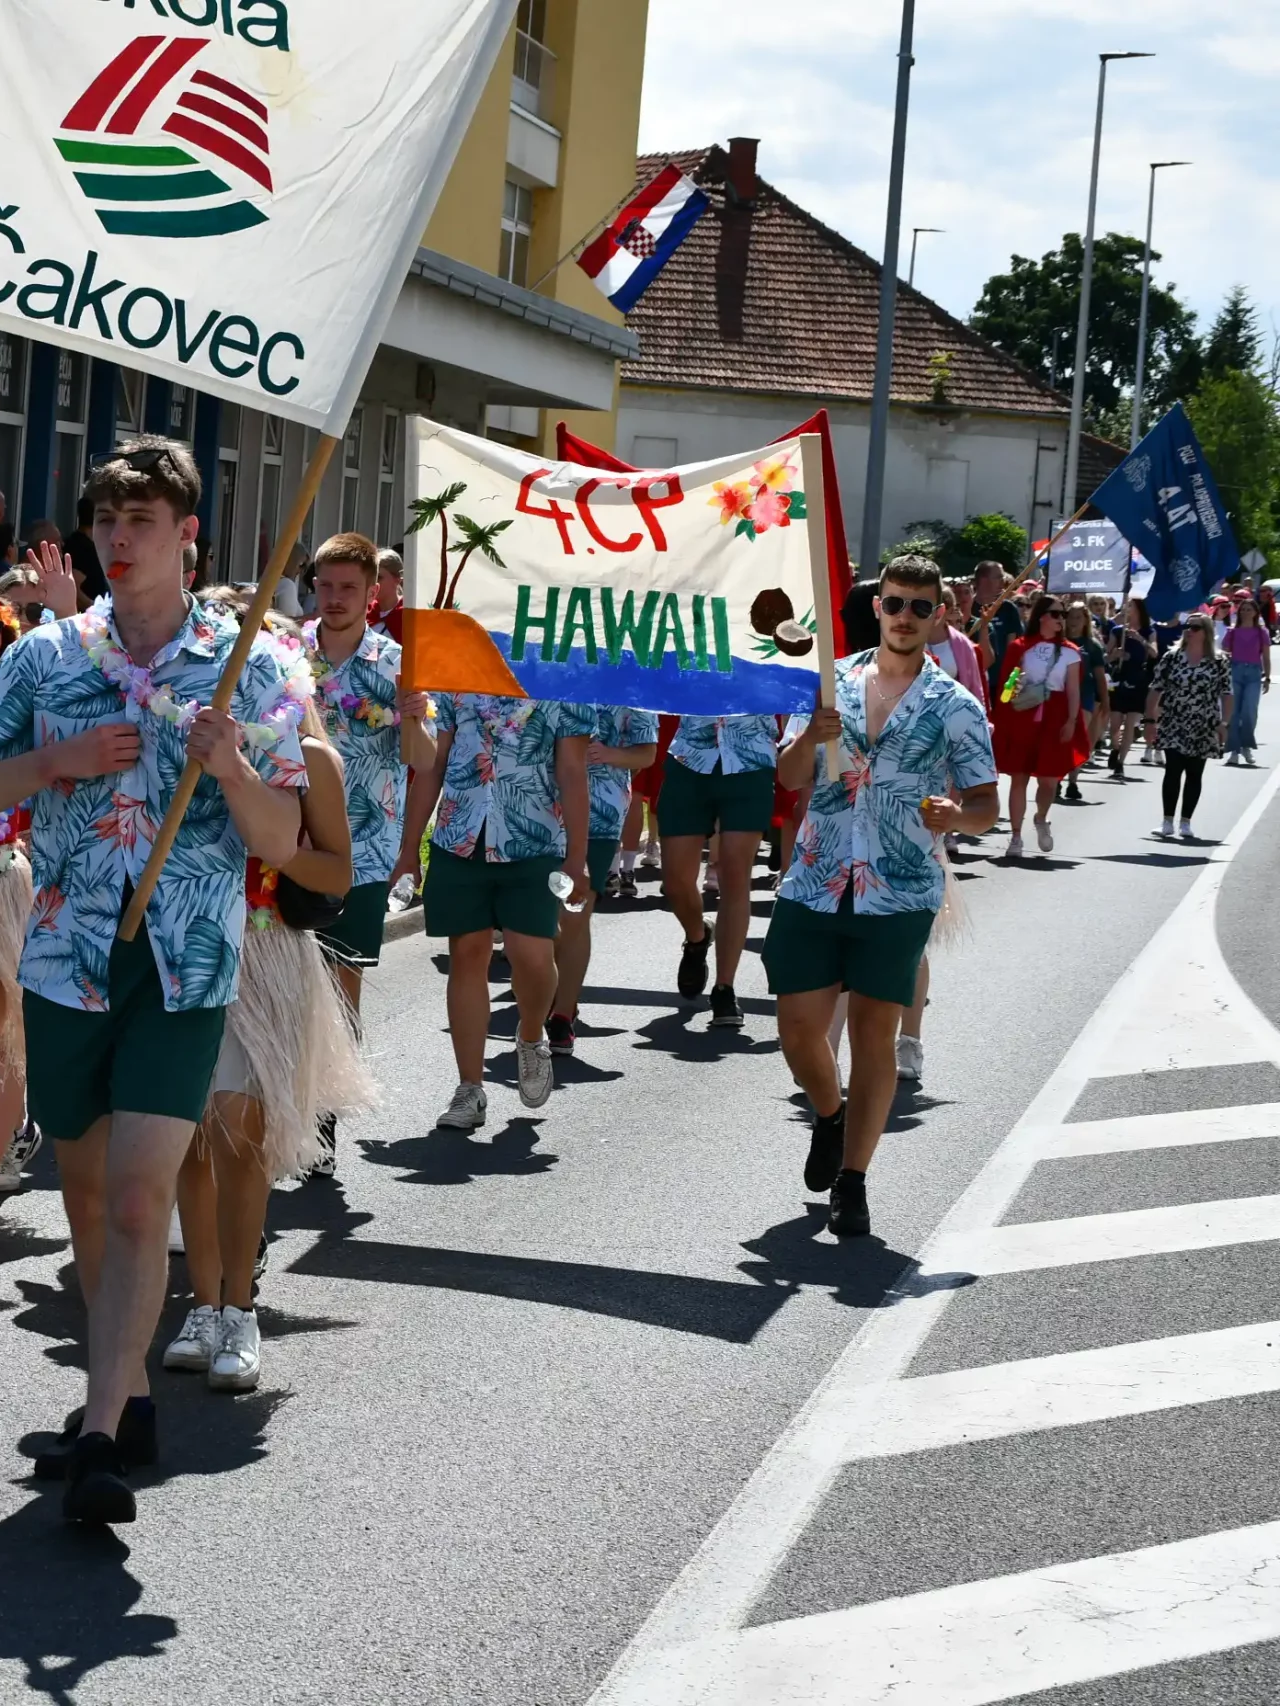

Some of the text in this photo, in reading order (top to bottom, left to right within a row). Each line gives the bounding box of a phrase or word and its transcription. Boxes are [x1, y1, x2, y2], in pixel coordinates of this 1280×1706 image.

[1072, 535, 1106, 547] 3. FK
[1063, 559, 1113, 572] POLICE
[511, 585, 733, 673] HAWAII
